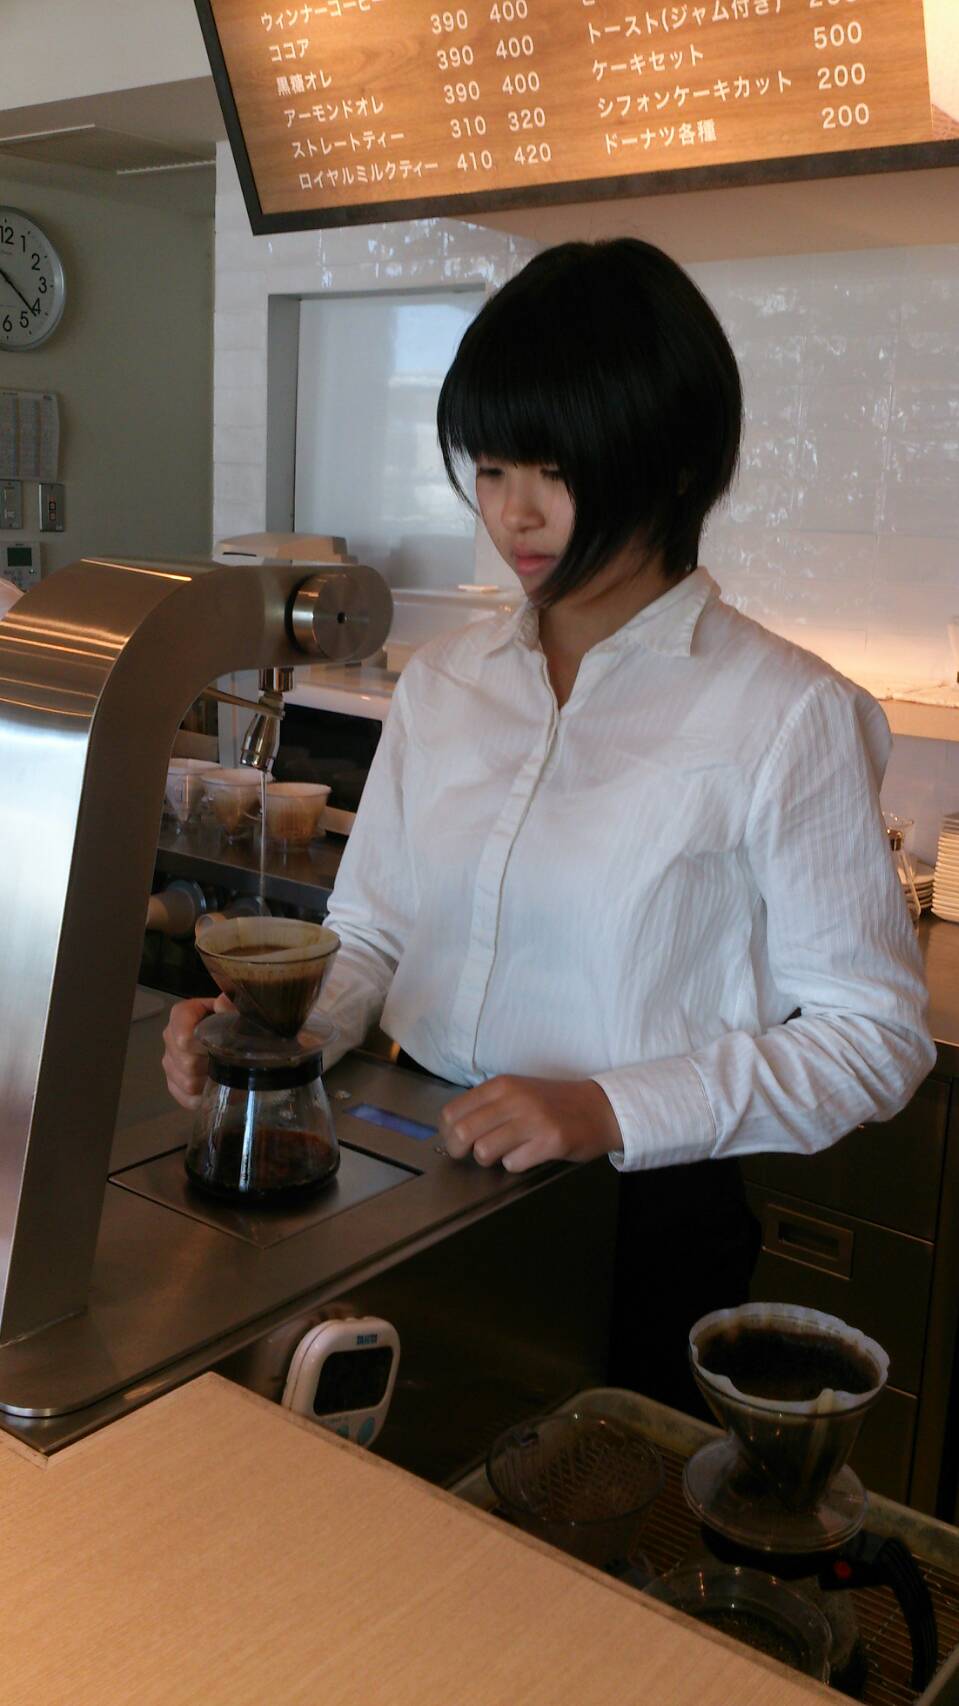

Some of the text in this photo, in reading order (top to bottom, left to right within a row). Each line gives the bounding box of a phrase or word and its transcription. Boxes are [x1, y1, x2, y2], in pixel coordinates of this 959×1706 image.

[269, 0, 528, 62] ココア 390 400
[592, 21, 863, 80] ケーキセット 500
[276, 35, 534, 96] 黒糖オレ 390 400
[284, 71, 540, 128] アーモンドオレ 390 400
[598, 63, 866, 118] シフォンケーキカット 200
[292, 107, 546, 158] ストレートティー 310 320
[605, 103, 870, 155] ドーナツ各種 200
[299, 142, 551, 189] ロイヤルミルクティー 410 420
[0, 225, 14, 245] 12
[20, 235, 26, 252] 1
[31, 253, 40, 271] 2
[38, 276, 47, 294] 3
[2, 314, 13, 332] 6
[19, 311, 29, 328] 5
[32, 298, 41, 314] 4
